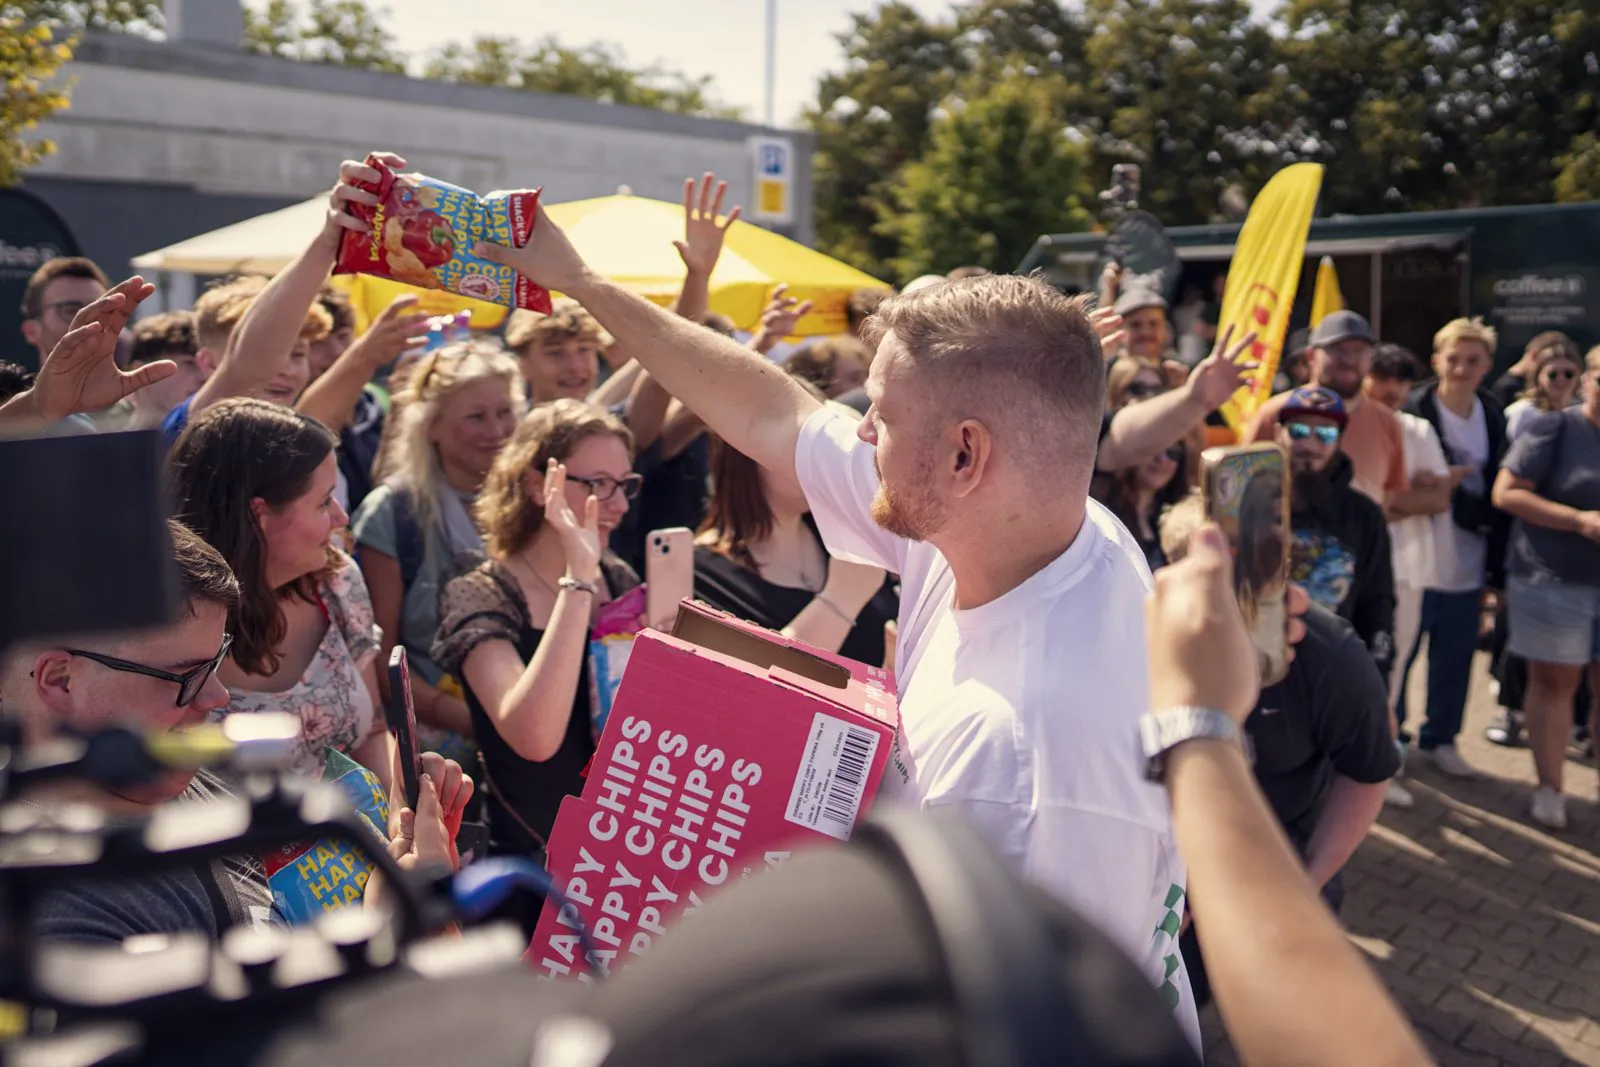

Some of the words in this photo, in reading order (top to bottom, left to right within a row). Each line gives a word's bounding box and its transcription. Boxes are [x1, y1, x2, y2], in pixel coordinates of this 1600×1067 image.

[537, 846, 606, 982] HAPPY
[588, 715, 652, 842] CHIPS
[577, 860, 642, 984] APPY
[624, 730, 689, 856] CHIPS
[627, 874, 679, 960] PPY
[661, 744, 726, 871] CHIPS
[698, 758, 762, 886] CHIPS
[894, 758, 909, 784] HIPS
